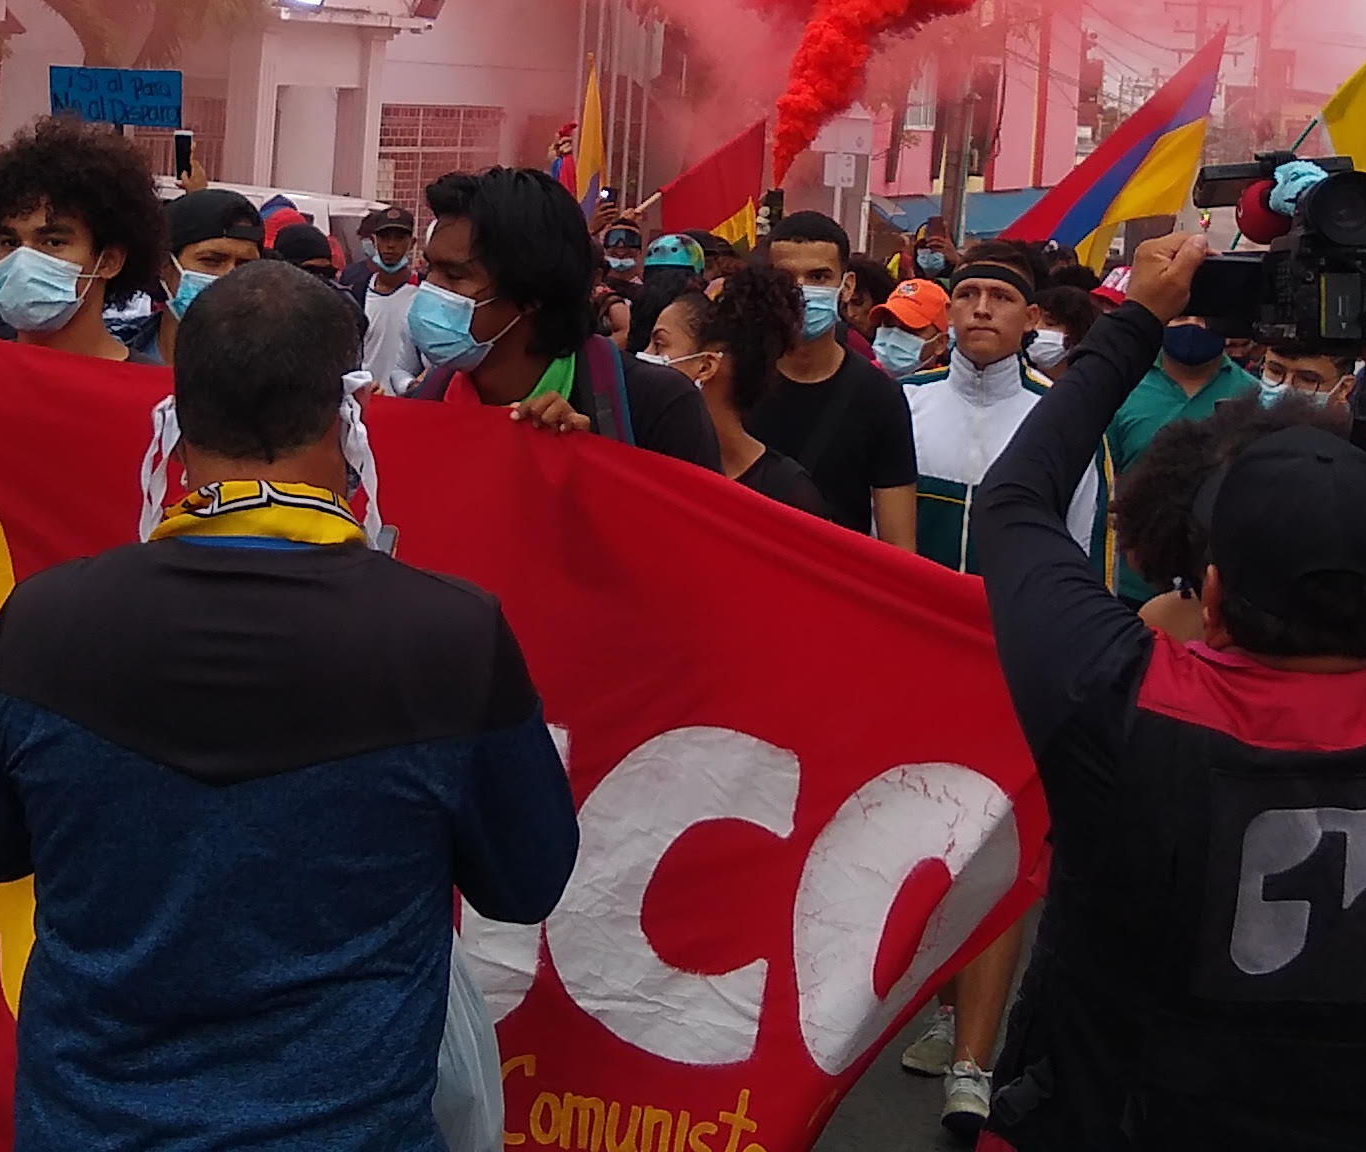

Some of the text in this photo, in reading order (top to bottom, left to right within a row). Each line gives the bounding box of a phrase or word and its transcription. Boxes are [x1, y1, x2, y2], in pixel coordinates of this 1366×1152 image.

[107, 72, 123, 93] al
[88, 95, 106, 121] al
[501, 1054, 767, 1152] Comunist
